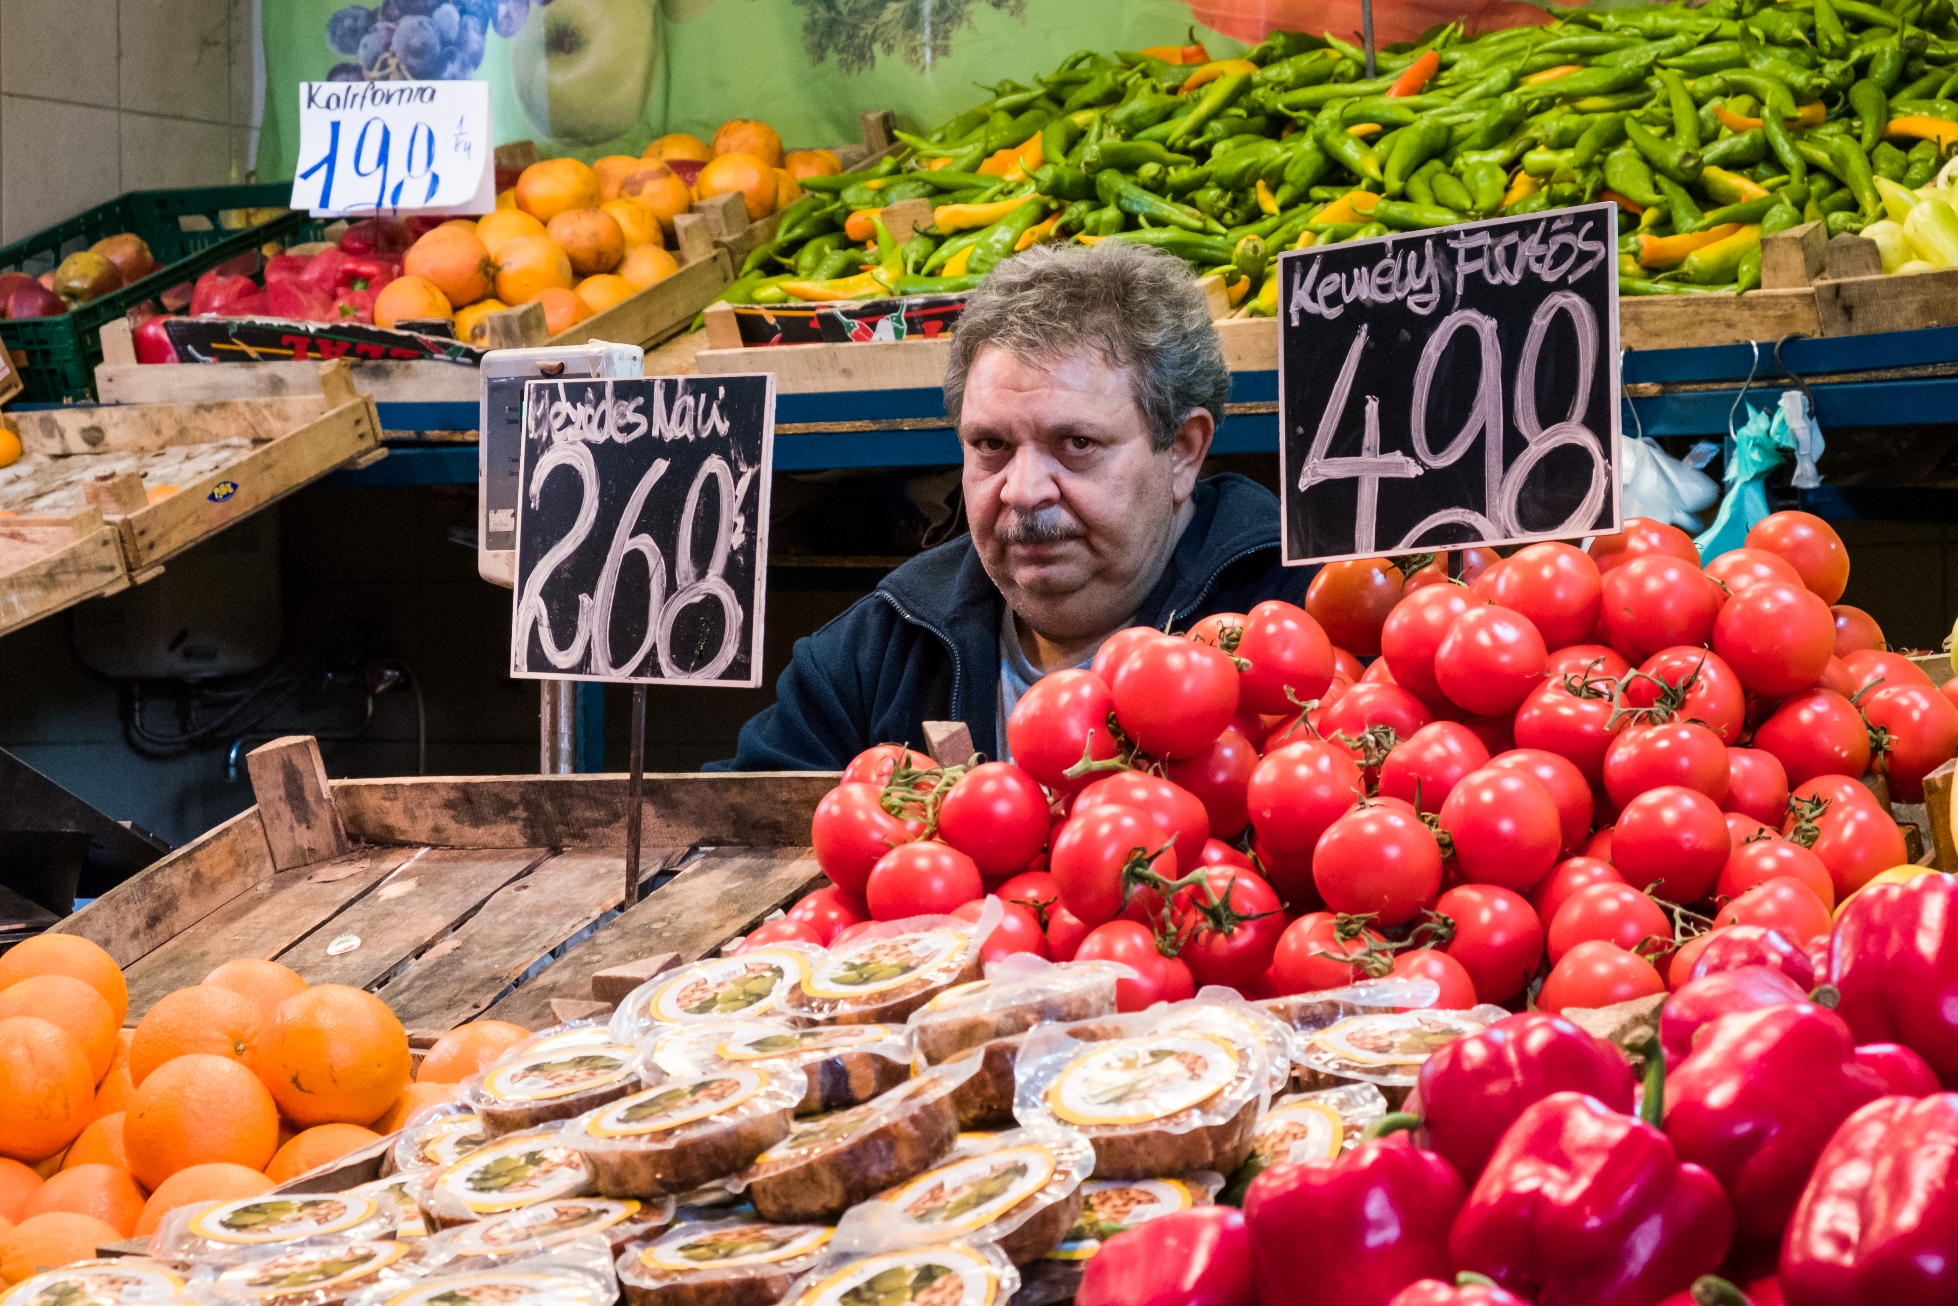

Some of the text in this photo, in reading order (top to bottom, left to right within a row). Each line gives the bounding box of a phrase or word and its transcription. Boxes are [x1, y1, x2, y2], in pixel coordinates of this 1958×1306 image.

[307, 81, 436, 111] Kalifornia
[1297, 289, 1613, 553] 498
[514, 440, 744, 680] 268
